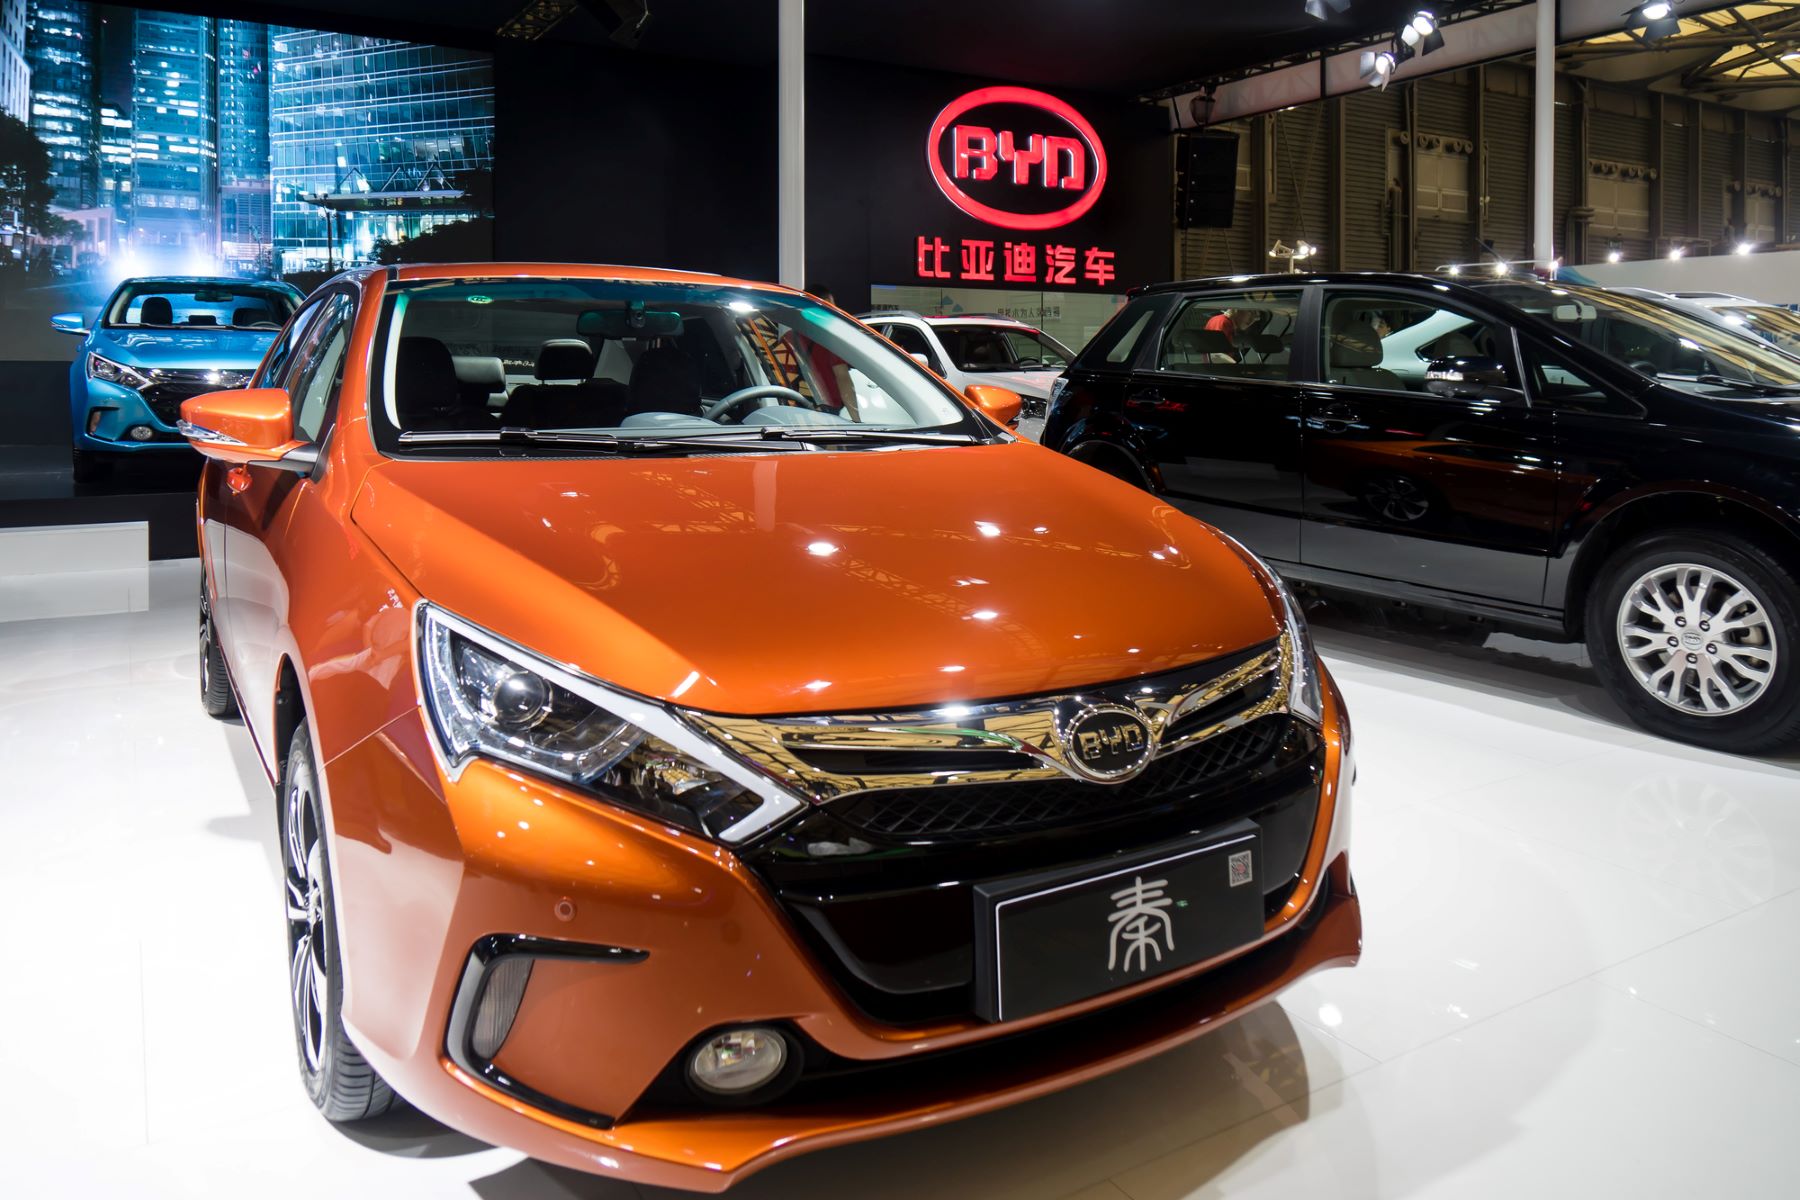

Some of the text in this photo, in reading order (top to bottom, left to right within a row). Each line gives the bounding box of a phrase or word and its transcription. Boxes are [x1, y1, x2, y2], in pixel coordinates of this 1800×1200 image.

[953, 124, 1086, 190] BYD
[917, 236, 1115, 286] 比亚迪汽车
[1079, 723, 1144, 760] BYD
[1107, 876, 1175, 973] 秦
